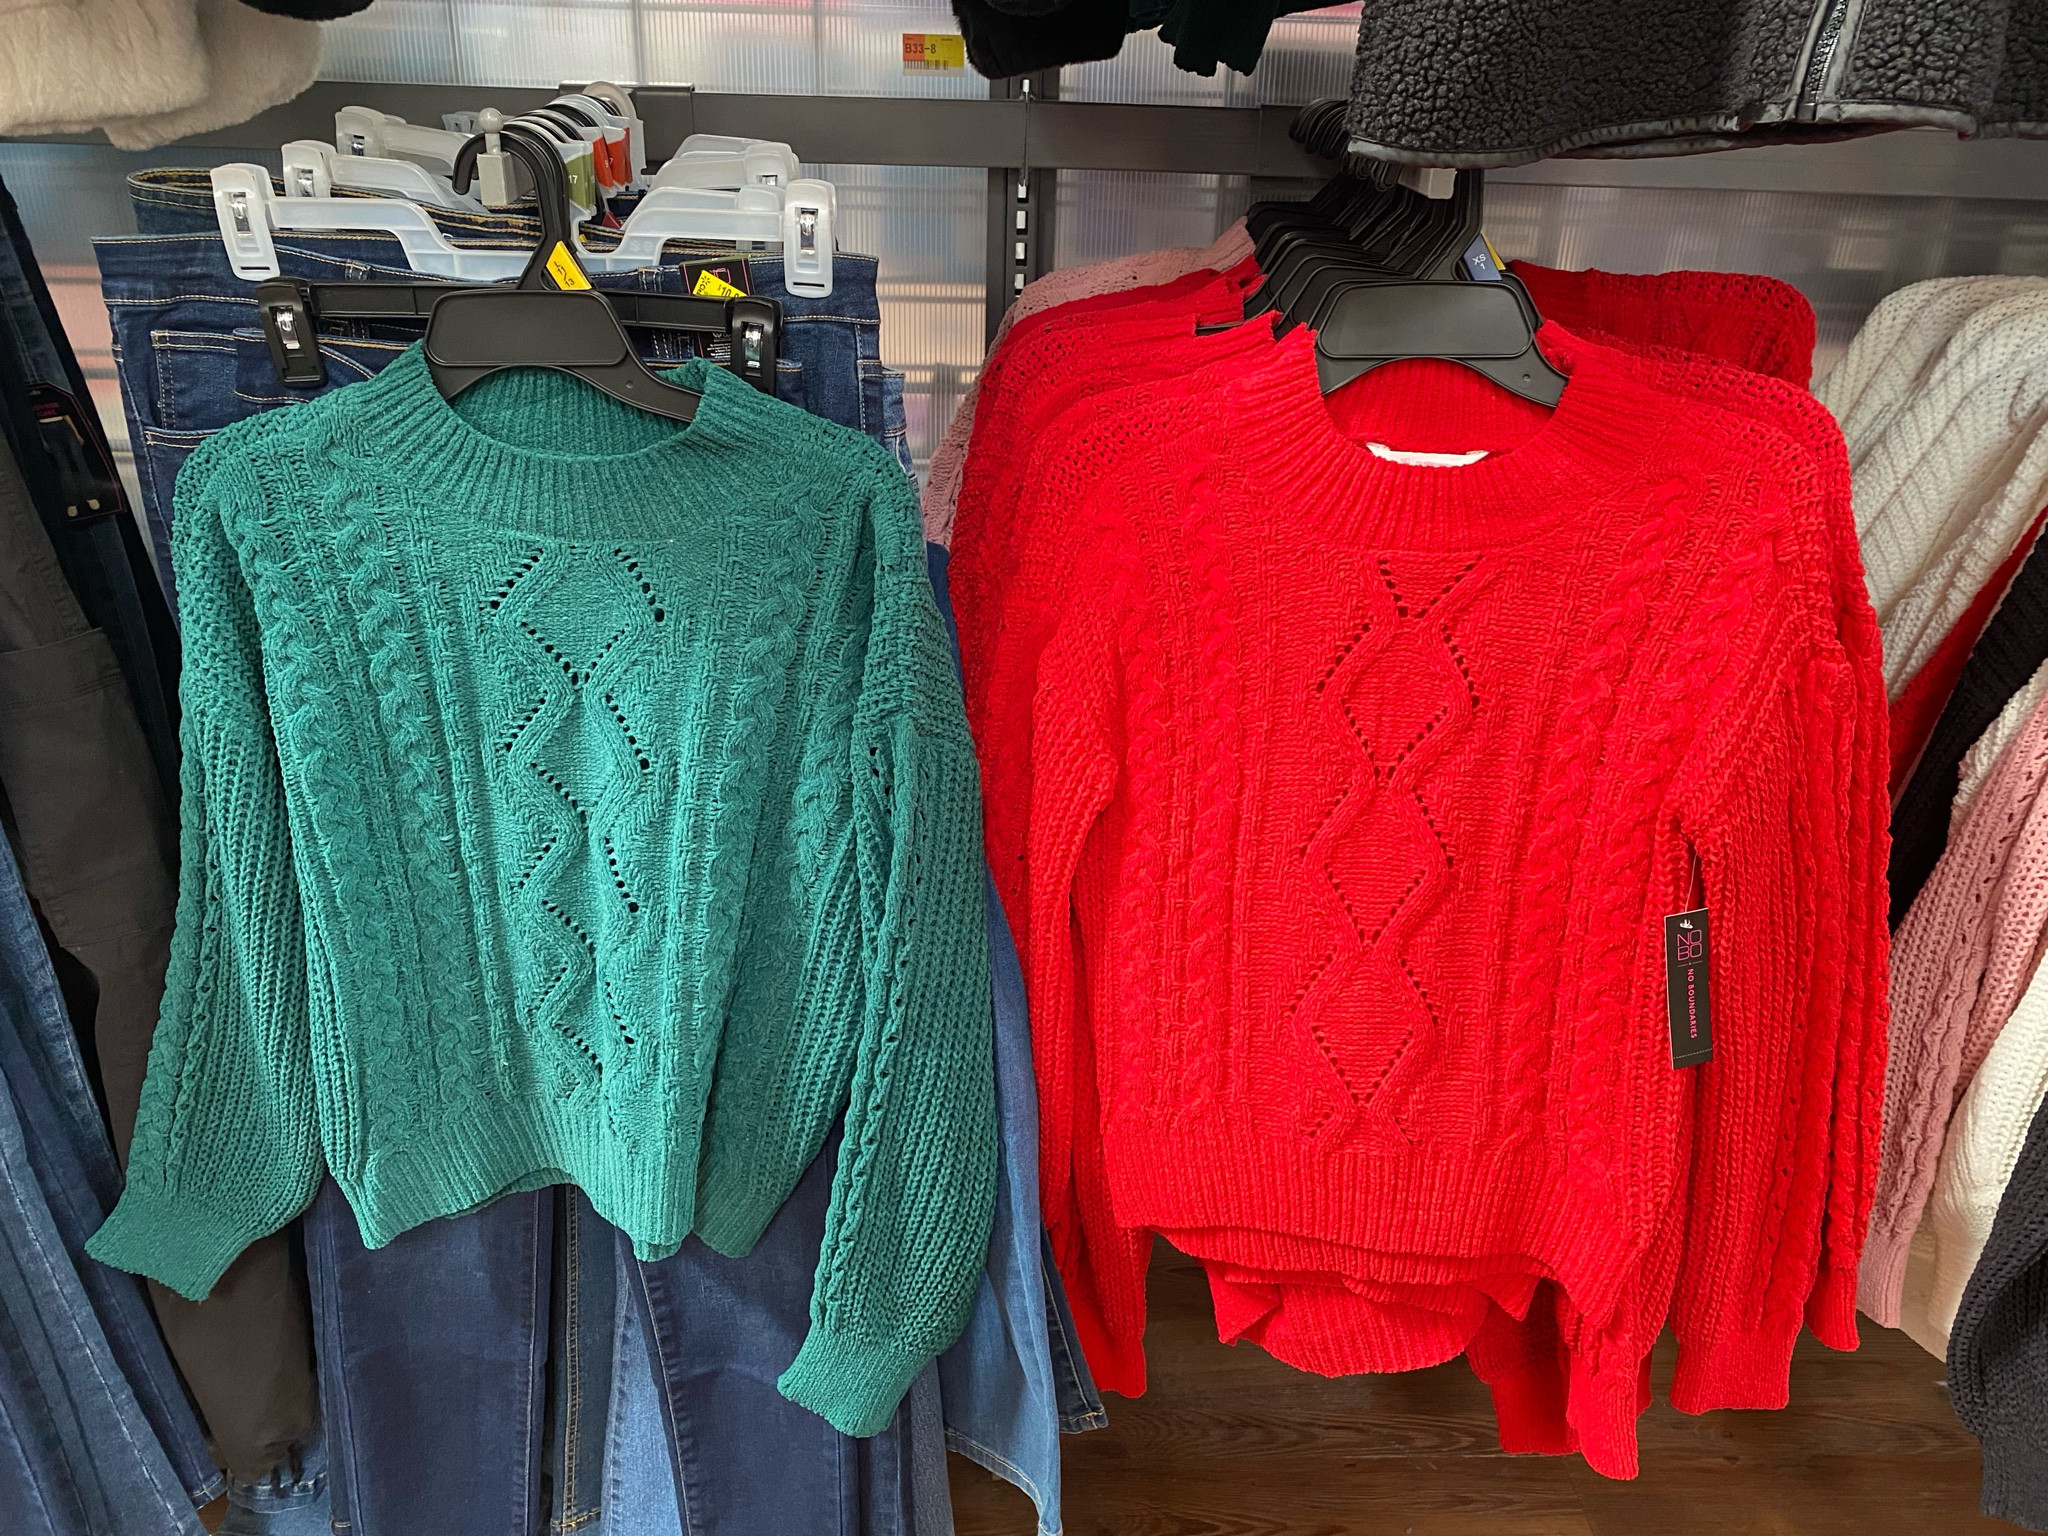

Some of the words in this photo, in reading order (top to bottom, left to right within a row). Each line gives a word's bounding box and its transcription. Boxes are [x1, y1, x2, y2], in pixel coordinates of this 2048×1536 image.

[905, 43, 937, 54] B33-8
[568, 174, 578, 184] 17
[1472, 254, 1486, 266] XS
[1677, 929, 1702, 947] NO
[1677, 942, 1702, 961] BO
[1687, 968, 1695, 982] NO
[1687, 983, 1698, 1040] BOUNDARIES
